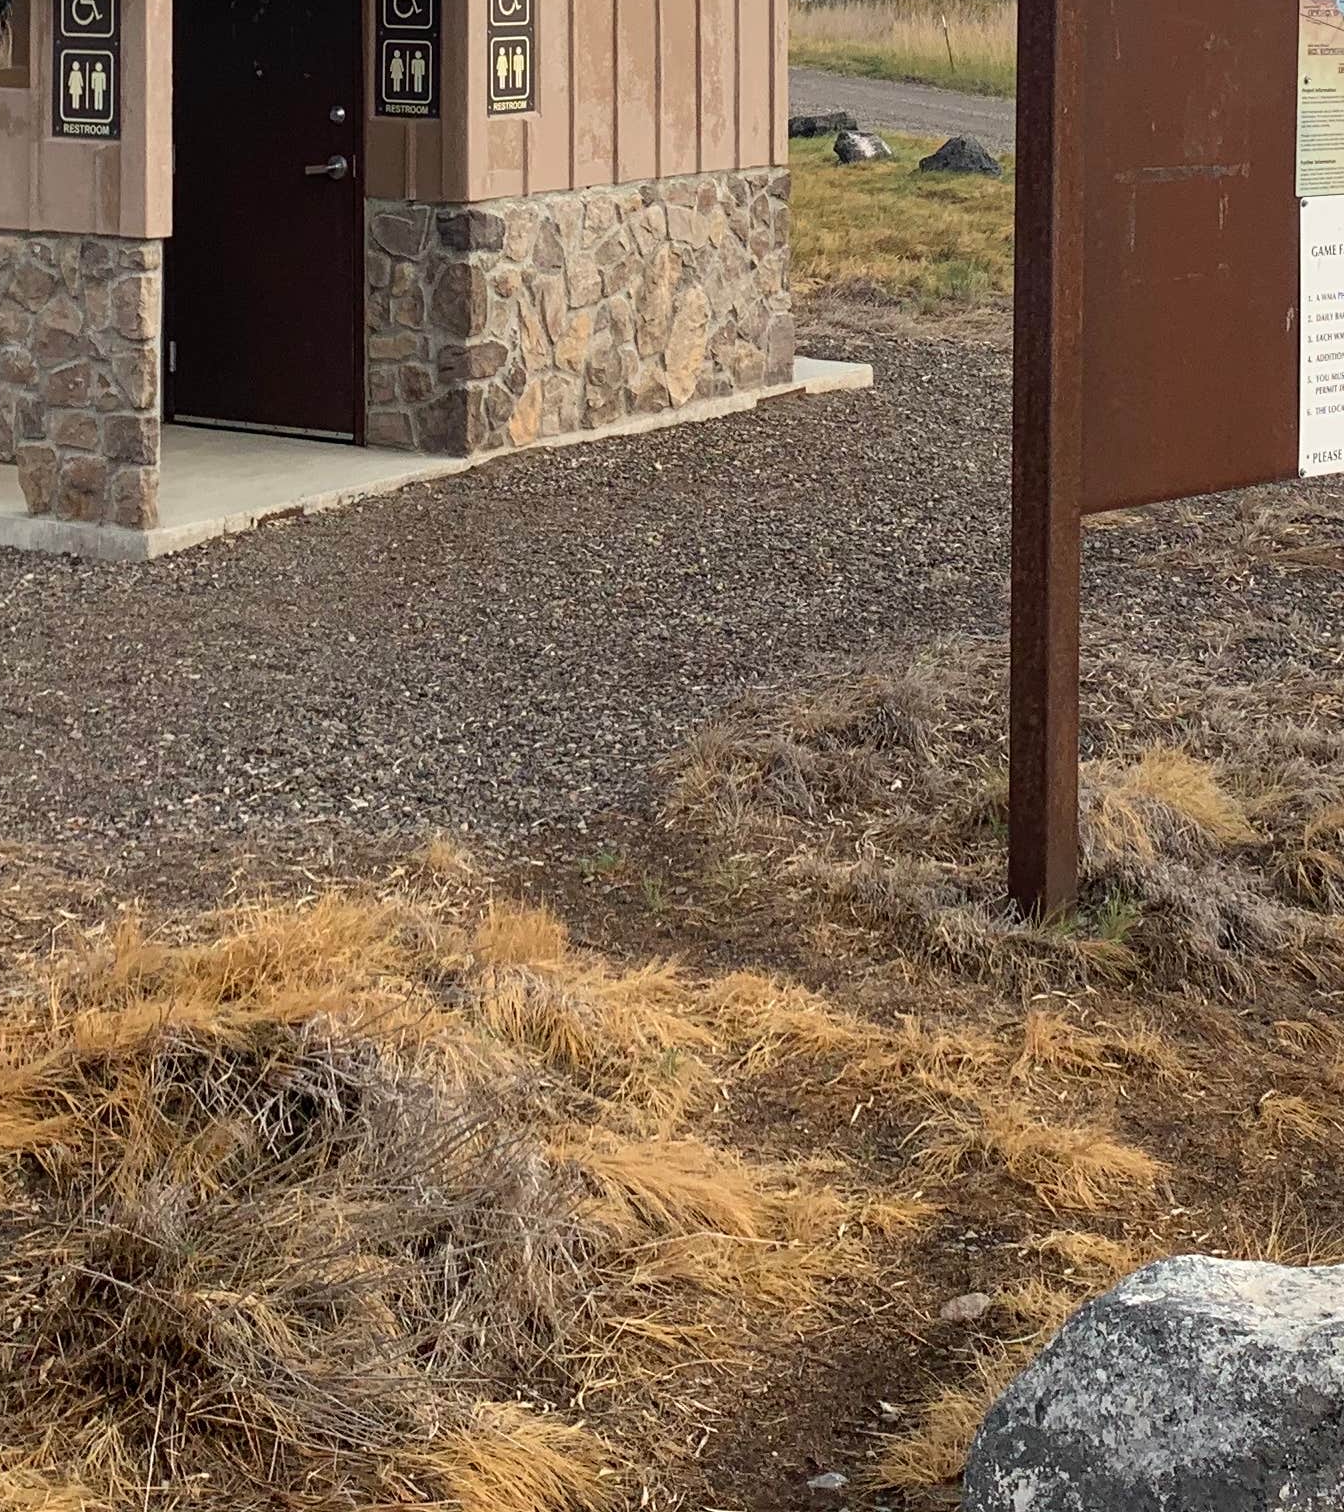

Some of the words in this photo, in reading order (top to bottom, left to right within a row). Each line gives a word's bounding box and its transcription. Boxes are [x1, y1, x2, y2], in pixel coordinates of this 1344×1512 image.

[385, 104, 429, 115] RESTROOM
[492, 99, 527, 111] RESTROOM
[63, 123, 110, 136] RESTROOM
[1311, 245, 1337, 257] GAME
[1312, 447, 1343, 464] PLEASE
